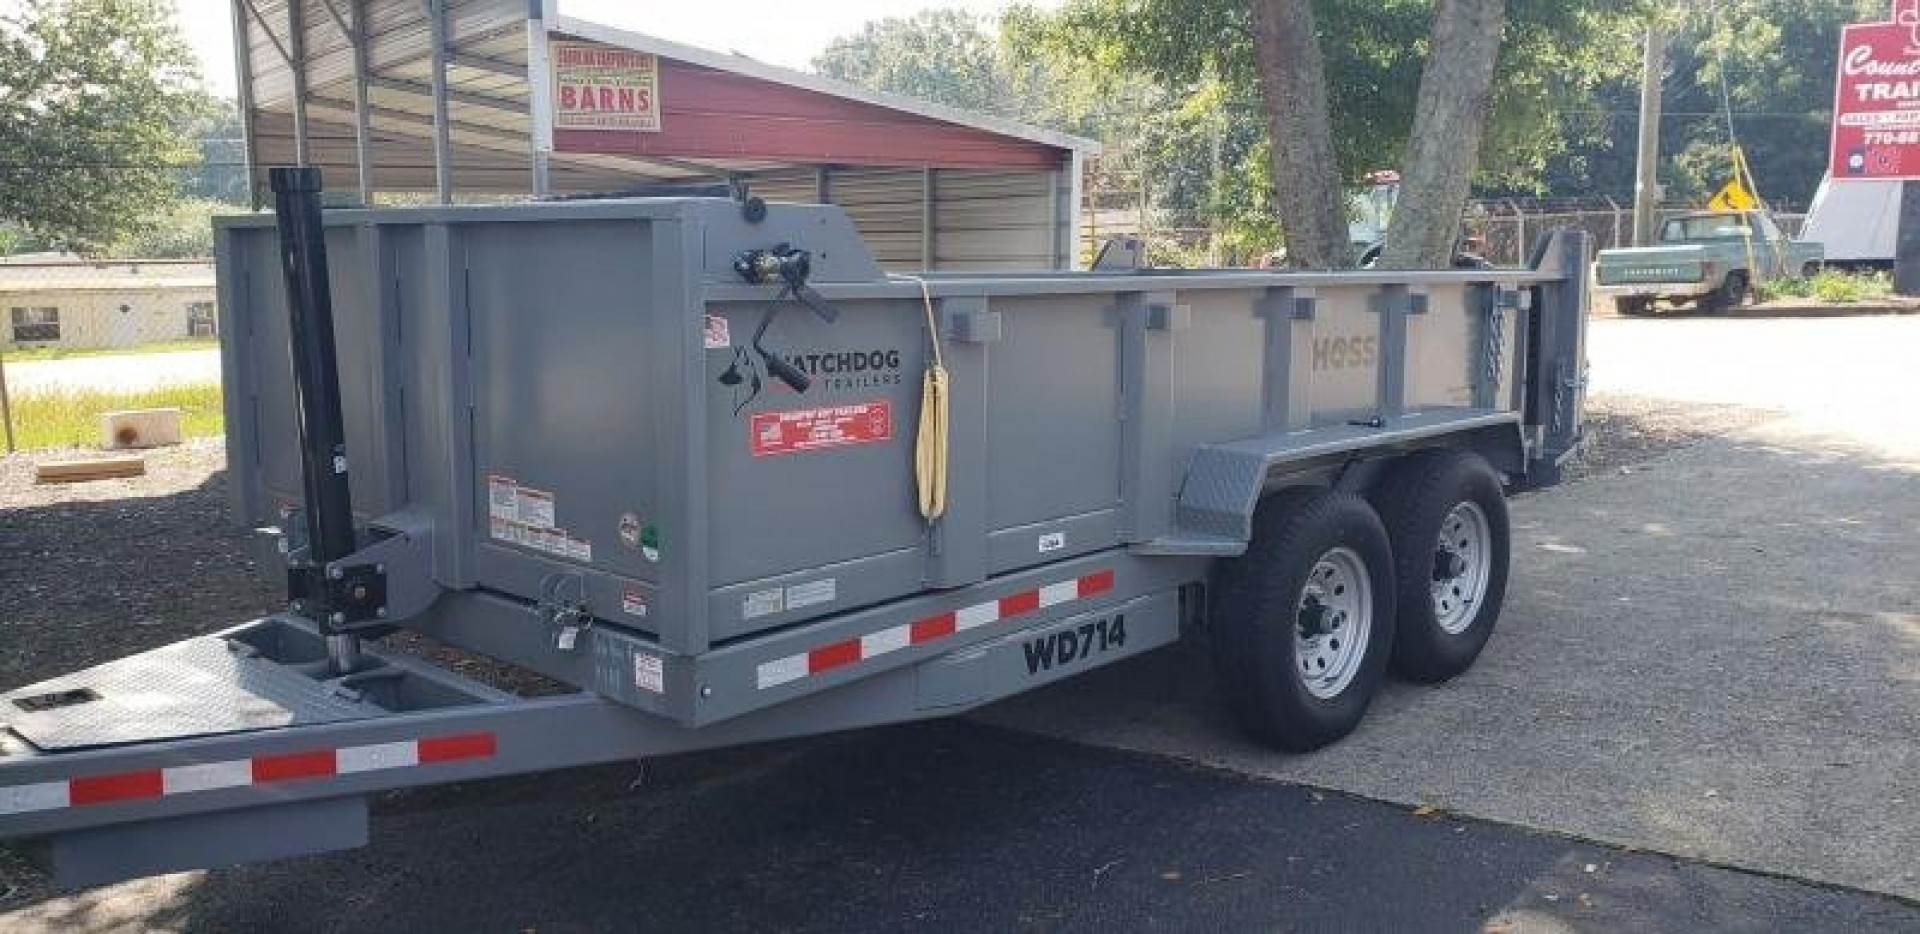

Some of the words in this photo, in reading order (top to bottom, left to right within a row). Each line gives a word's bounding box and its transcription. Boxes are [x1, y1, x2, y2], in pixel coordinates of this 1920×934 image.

[559, 85, 649, 113] BARNS
[1312, 335, 1376, 371] HOSS
[824, 374, 901, 391] TRAILERS
[1022, 614, 1127, 676] WD714
